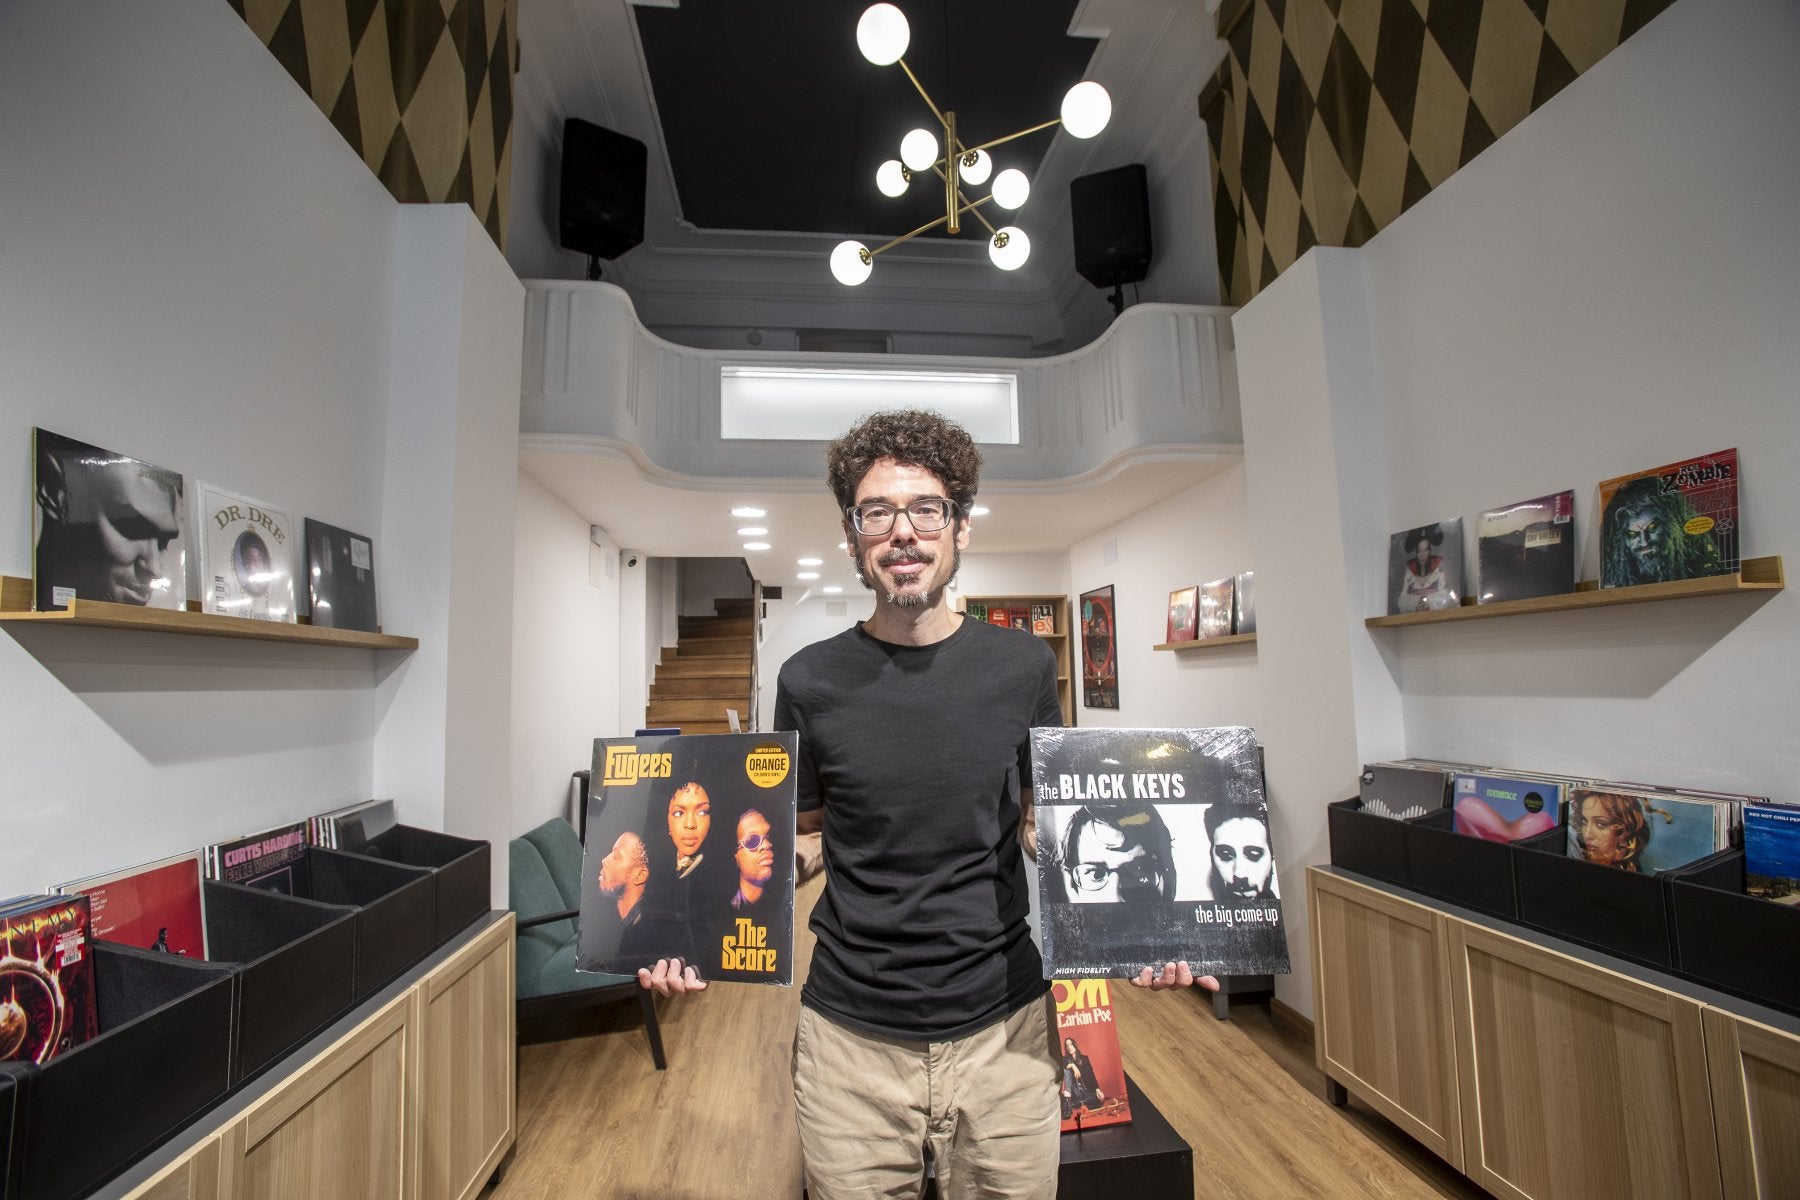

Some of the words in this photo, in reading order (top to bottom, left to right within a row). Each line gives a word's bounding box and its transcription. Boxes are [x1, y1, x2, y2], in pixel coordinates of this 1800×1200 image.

[1660, 461, 1732, 495] ZOMBIE
[214, 505, 246, 530] DR.
[247, 506, 286, 545] DRE
[603, 745, 672, 787] Fugees
[749, 758, 786, 770] ORANGE
[1040, 782, 1058, 799] the
[1059, 773, 1127, 799] BLACK
[1132, 773, 1186, 798] KEYS
[225, 842, 261, 868] CURTIS
[262, 830, 303, 855] HARDING
[1195, 905, 1213, 923] the
[1215, 904, 1233, 927] big
[1235, 908, 1263, 922] come
[1265, 908, 1279, 926] up
[735, 918, 767, 947] The
[722, 935, 777, 971] Score
[1056, 967, 1075, 975] HIGH
[1057, 1011, 1092, 1028] Larkin
[1093, 1008, 1111, 1023] Poe
